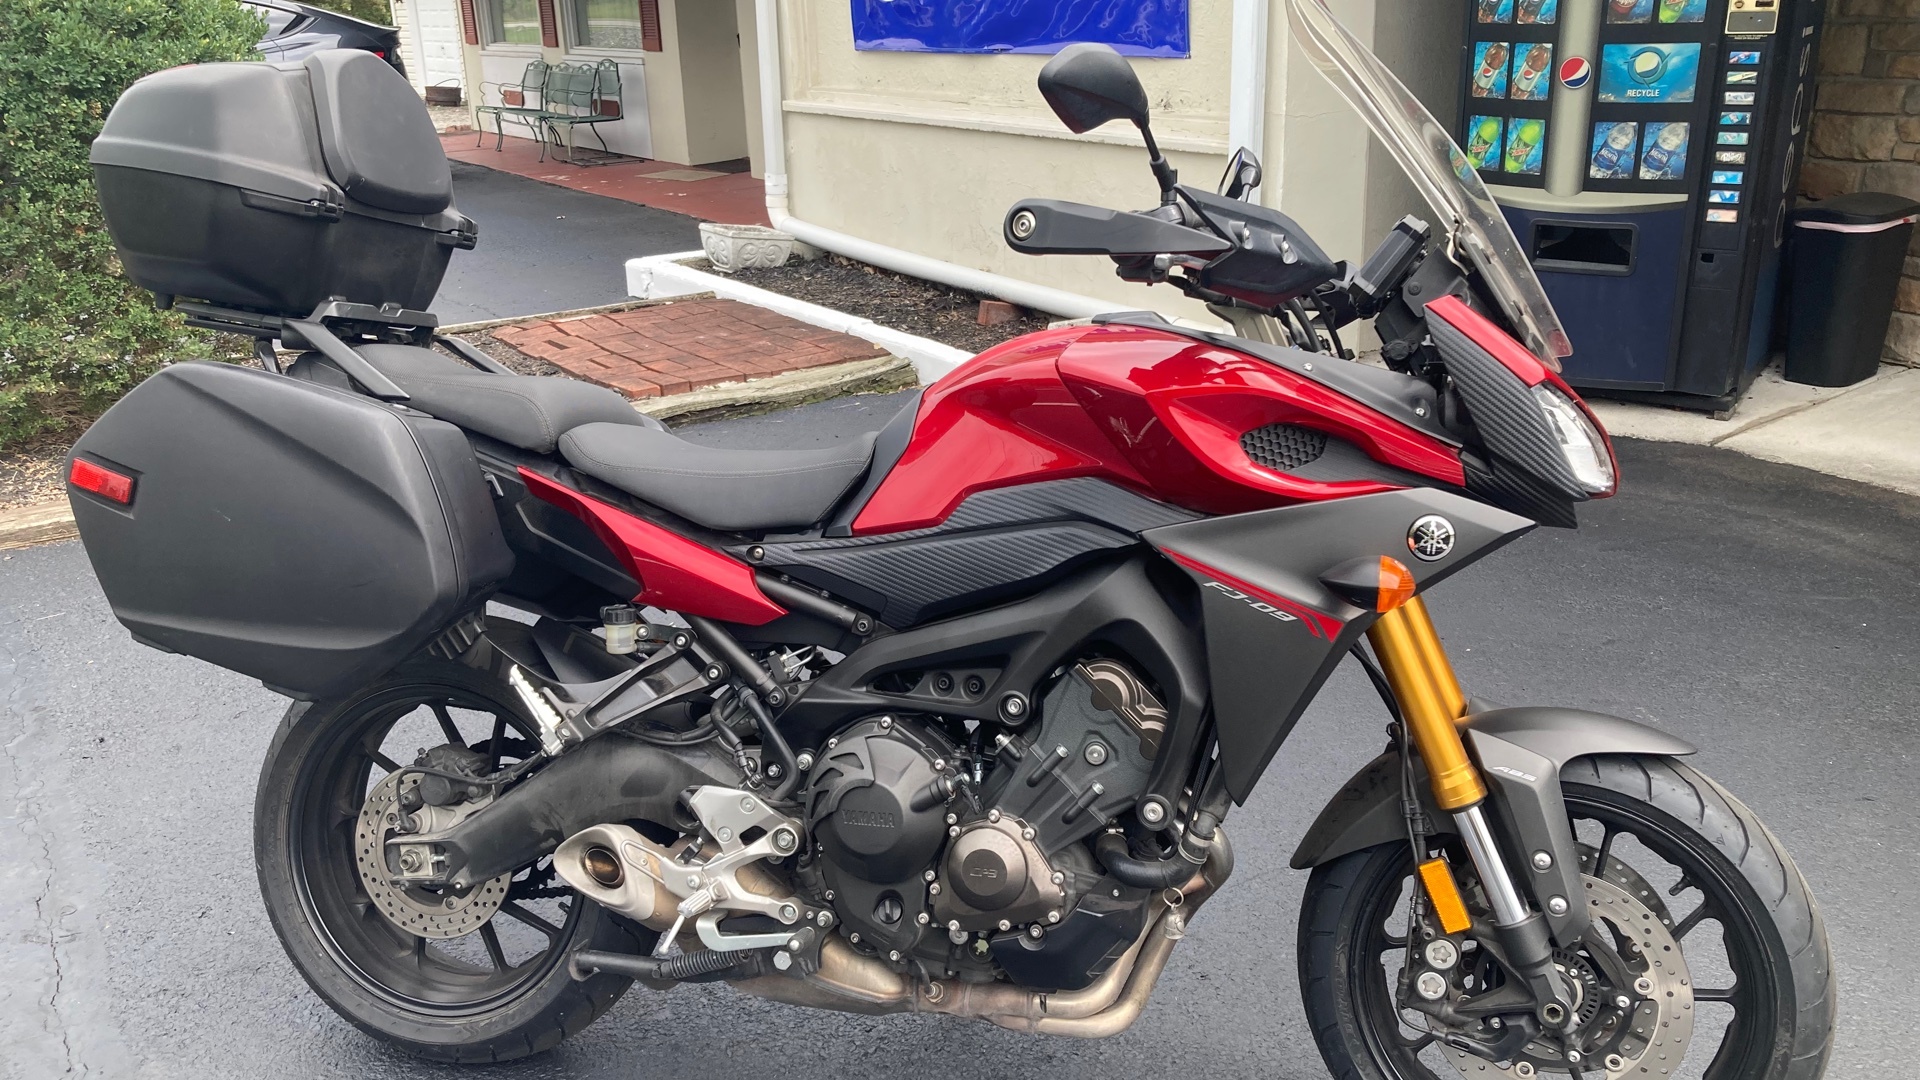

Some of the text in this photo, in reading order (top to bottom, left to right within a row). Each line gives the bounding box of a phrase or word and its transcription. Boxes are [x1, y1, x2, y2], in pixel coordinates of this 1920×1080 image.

[1626, 88, 1660, 97] RECYCLE
[1203, 581, 1298, 622] FJ-09
[841, 809, 895, 829] YAMAHA
